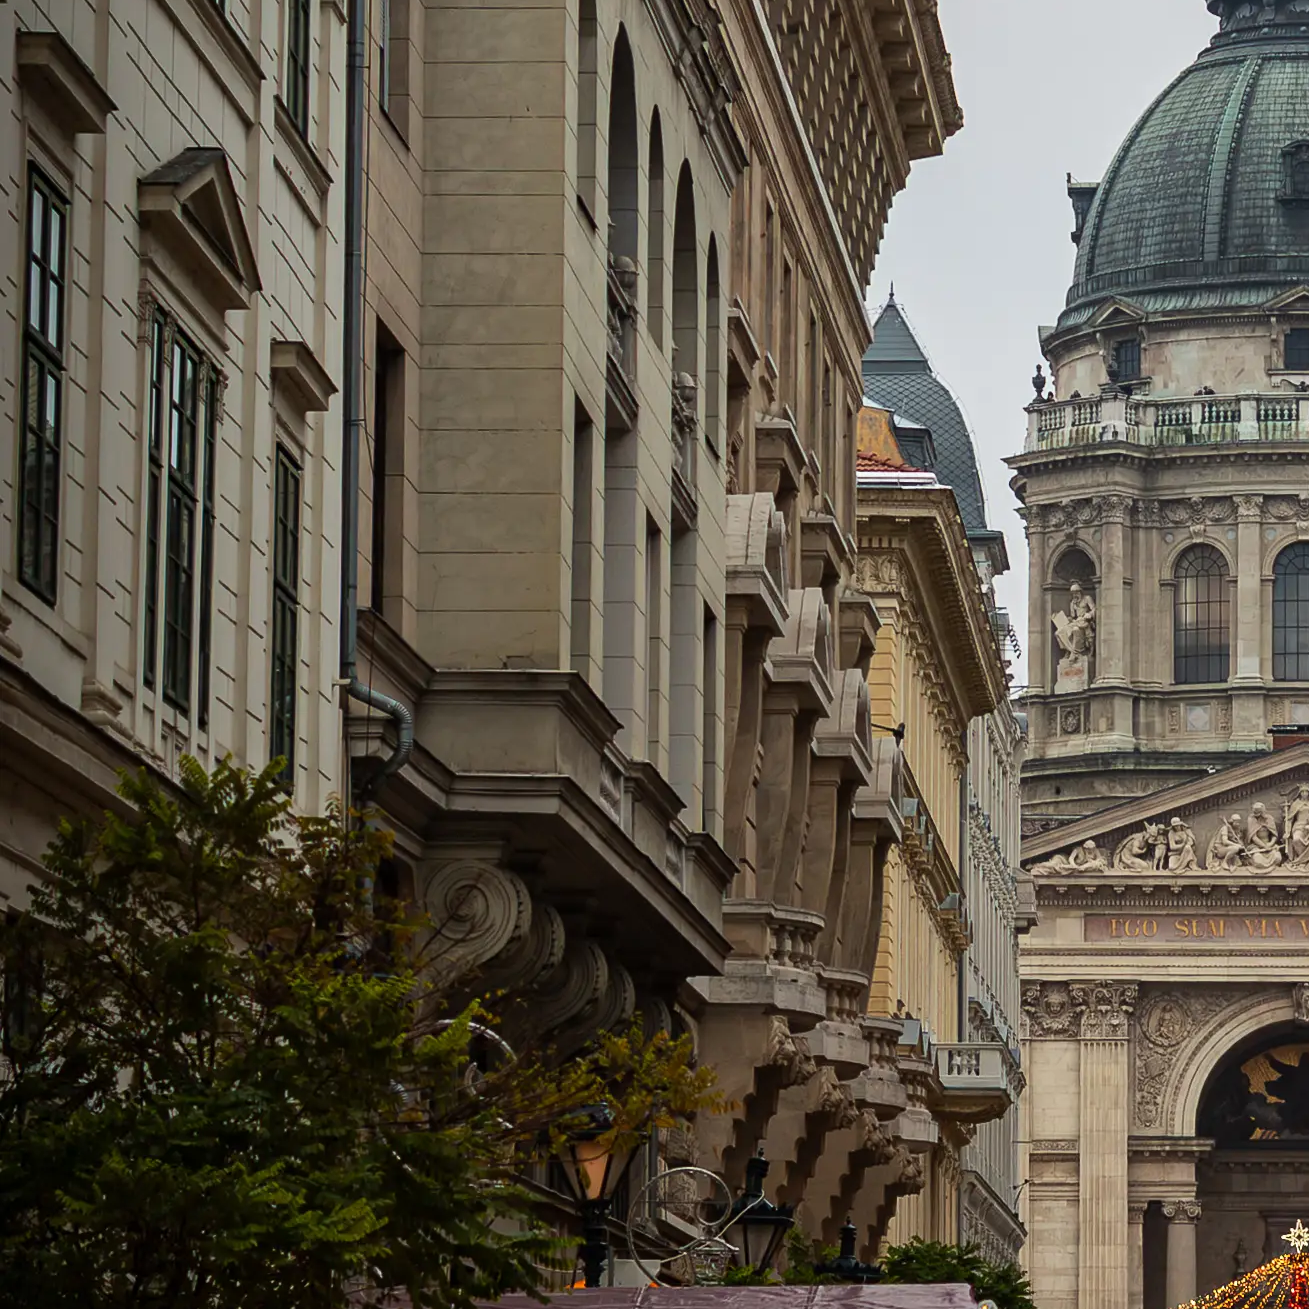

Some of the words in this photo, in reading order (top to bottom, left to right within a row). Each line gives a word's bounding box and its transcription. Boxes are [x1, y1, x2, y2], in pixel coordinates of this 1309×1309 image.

[1109, 918, 1159, 938] EGO
[1174, 918, 1226, 938] SUM
[1244, 918, 1284, 938] VIA
